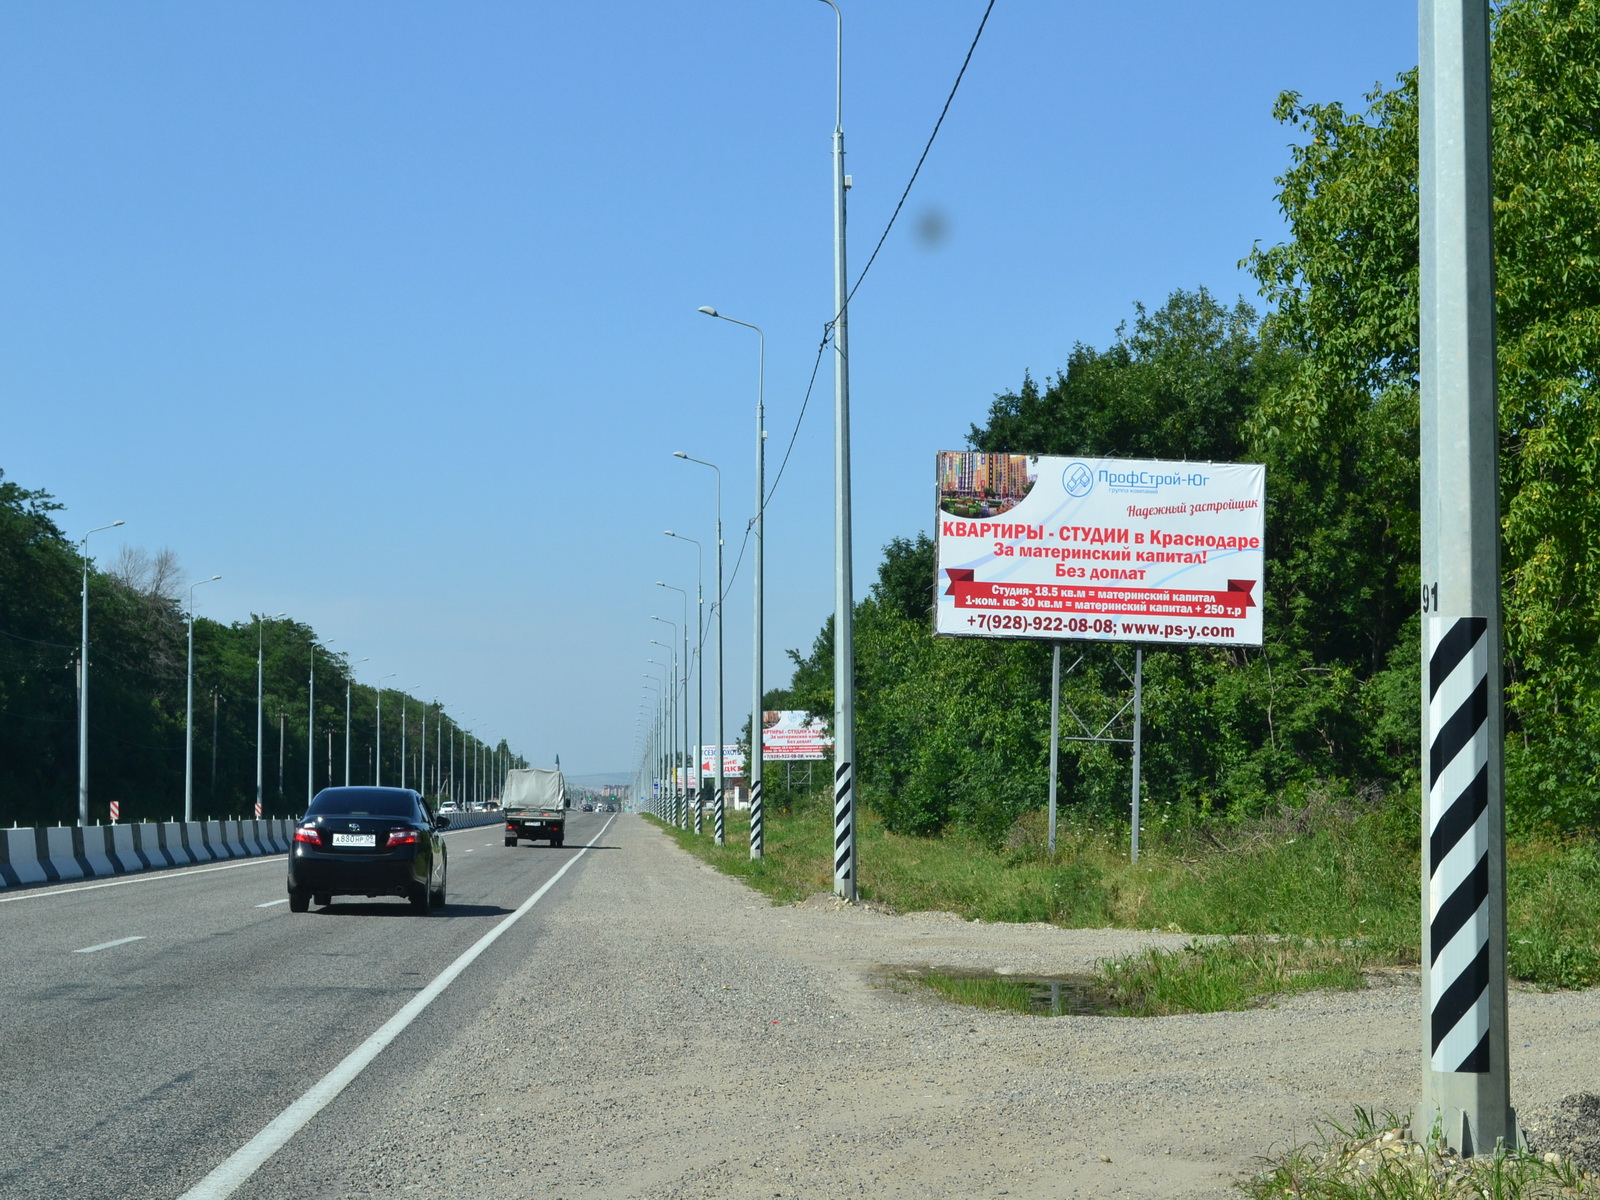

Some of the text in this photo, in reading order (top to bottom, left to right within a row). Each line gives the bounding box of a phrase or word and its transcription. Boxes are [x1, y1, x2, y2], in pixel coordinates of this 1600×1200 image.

[1098, 469, 1210, 488] ПрофСтрой-Юг
[1109, 487, 1129, 495] группа
[1126, 499, 1259, 519] Надежный застройщик
[942, 521, 1044, 540] КВАРТИРЫ
[1058, 525, 1129, 545] СТУДИИ
[1134, 532, 1145, 544] в
[1149, 529, 1260, 551] Краснодаре
[993, 542, 1207, 564] За материнский капитал!
[1055, 563, 1146, 580] Без доплат
[991, 584, 1033, 597] Студия-
[1034, 586, 1059, 597] 18.5
[1061, 589, 1086, 598] кв.м
[1097, 590, 1170, 602] материнский
[1172, 594, 1216, 603] капитал
[1422, 582, 1438, 613] 91
[965, 595, 1000, 607] 1-ком.
[1002, 599, 1019, 607] кв-
[1021, 597, 1035, 608] 30
[1037, 600, 1063, 609] кв.м
[1074, 601, 1147, 612] материнский
[1149, 604, 1193, 614] капитал
[1195, 605, 1202, 613] +
[1204, 604, 1225, 615] 250
[1226, 606, 1242, 617] т.р
[967, 614, 1235, 640] +7(928)-922-08-08; www.ps-y.com
